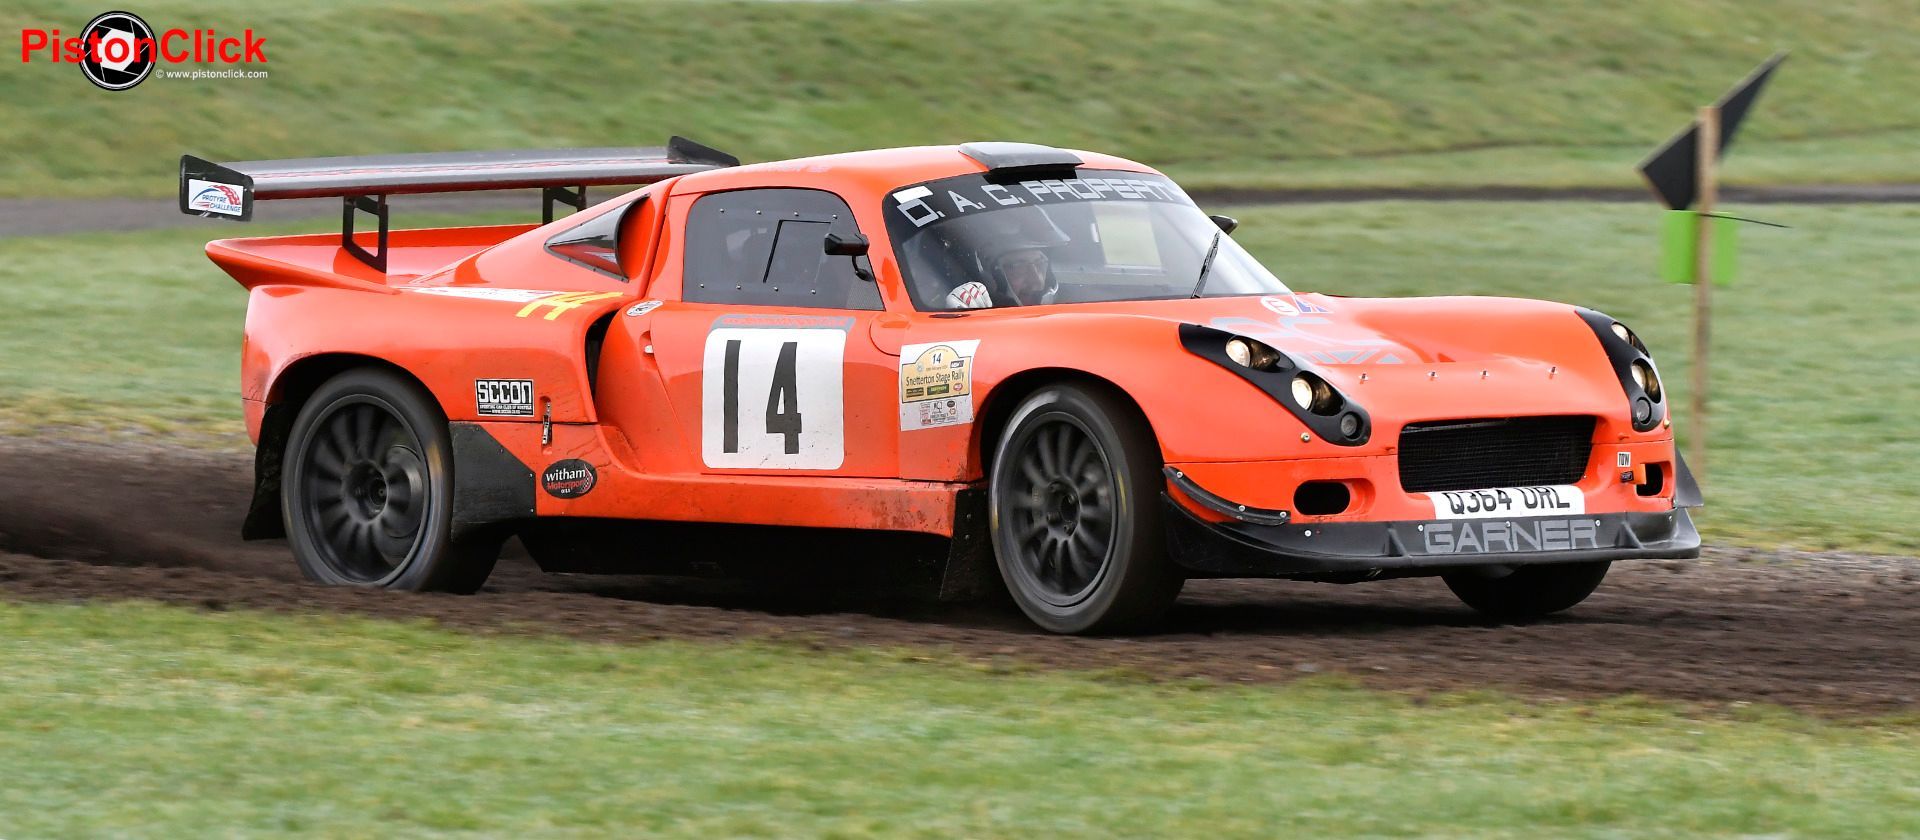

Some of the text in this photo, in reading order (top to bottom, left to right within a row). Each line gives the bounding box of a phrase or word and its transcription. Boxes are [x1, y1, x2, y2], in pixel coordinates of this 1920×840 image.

[202, 194, 227, 202] PROTYRE
[947, 190, 986, 213] A.
[1019, 178, 1178, 202] PROPERT
[210, 203, 241, 212] CHALLENGE
[932, 353, 942, 364] 14
[906, 369, 965, 387] Snetterton Stage Rally
[723, 339, 803, 455] 14
[1618, 453, 1630, 466] TOW
[545, 467, 586, 482] witham
[1442, 489, 1512, 515] Q364
[1423, 519, 1599, 554] GARNER
